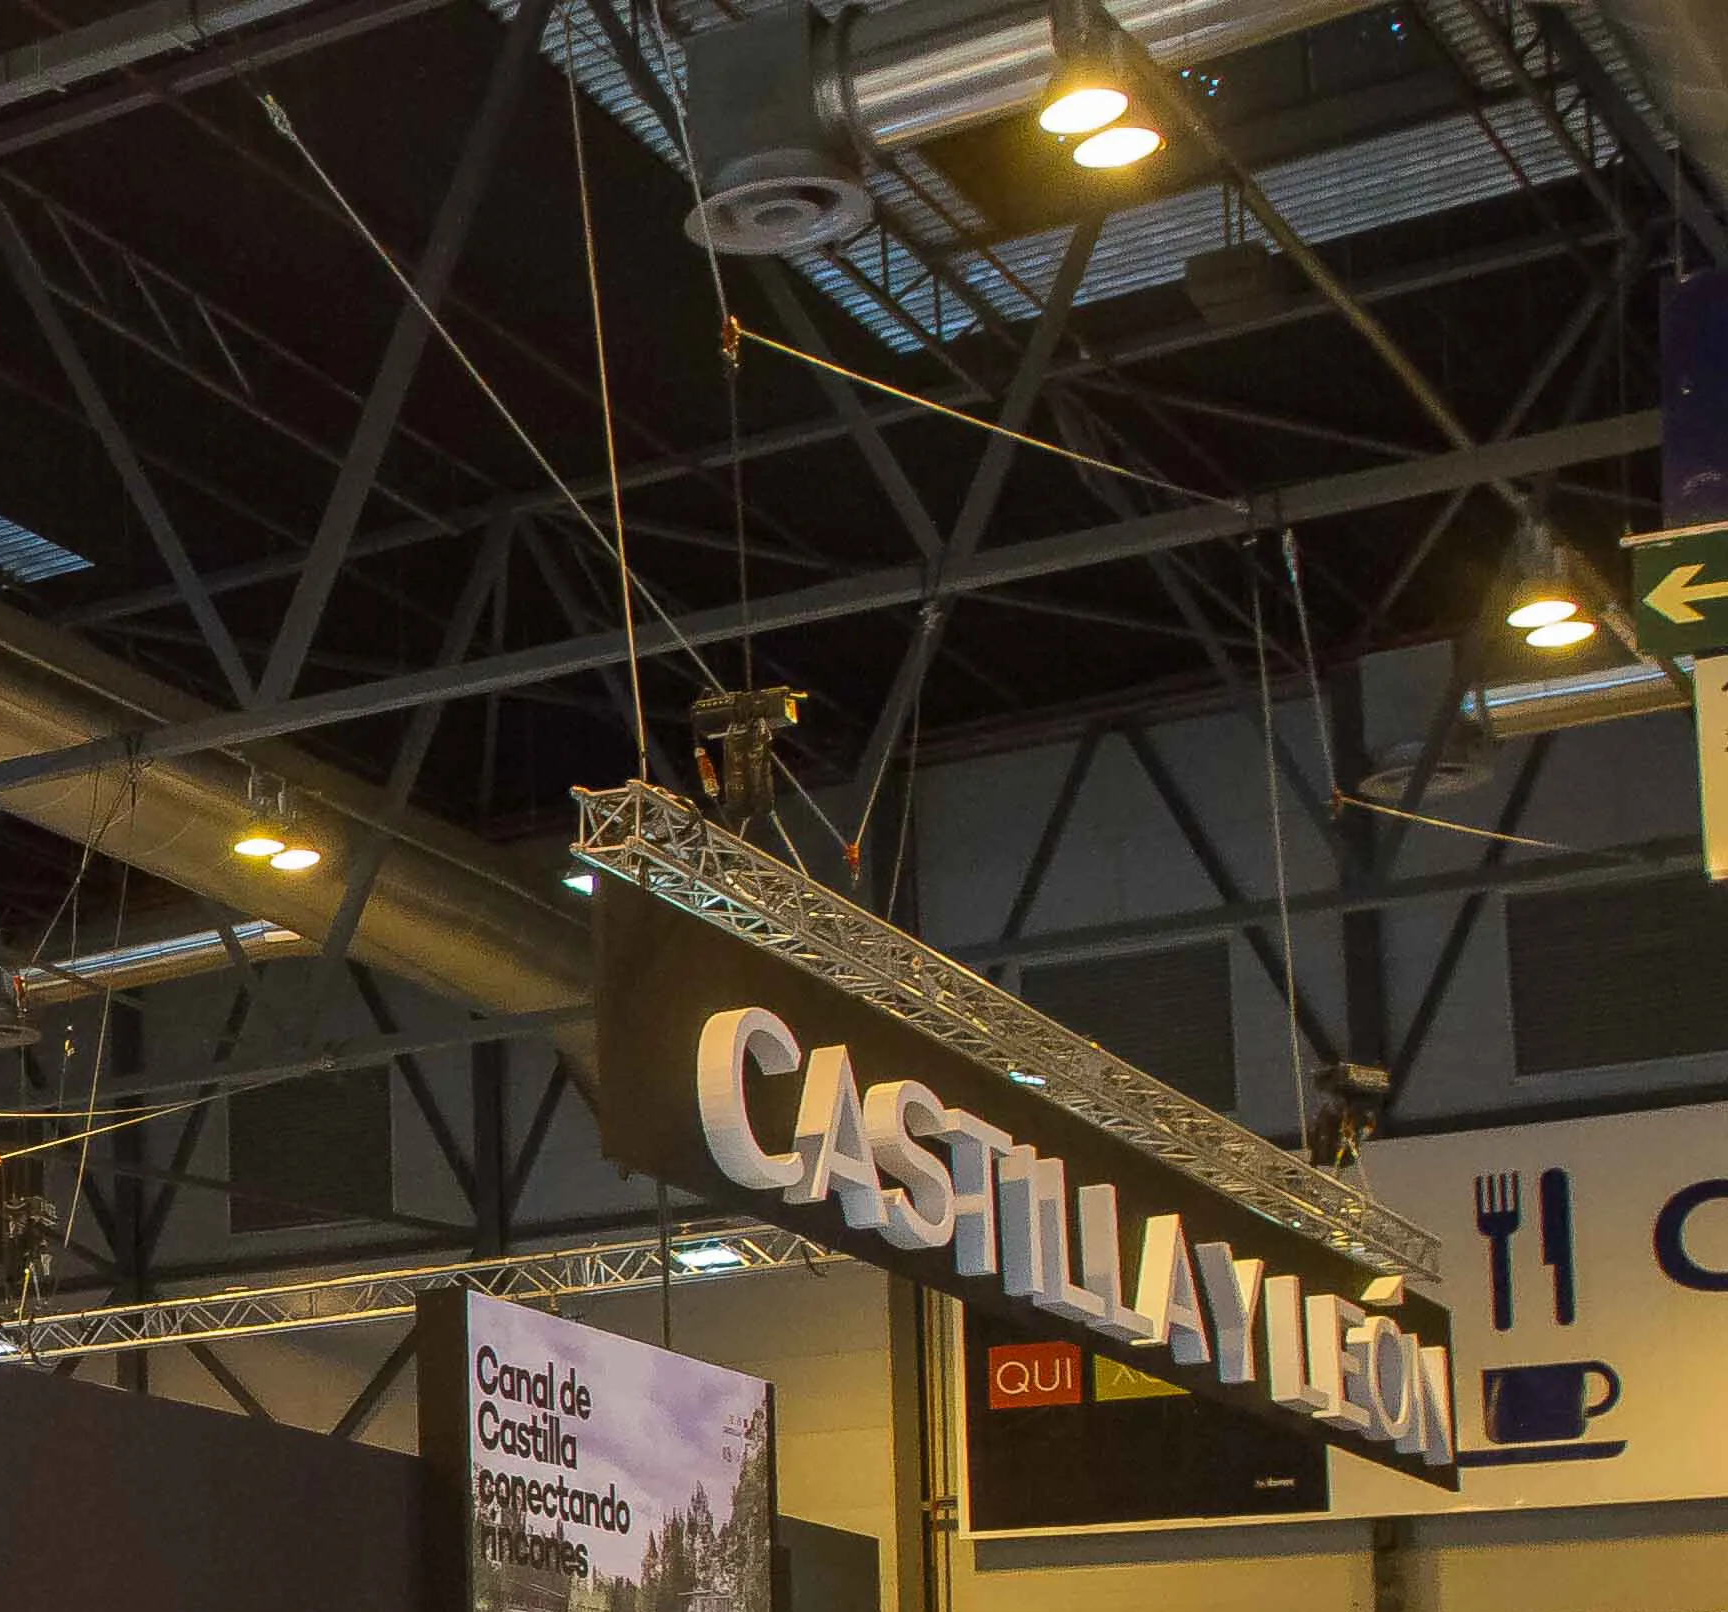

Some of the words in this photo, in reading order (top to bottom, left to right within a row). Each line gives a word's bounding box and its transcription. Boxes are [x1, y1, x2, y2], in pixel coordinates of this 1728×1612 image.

[697, 1007, 1212, 1366] CASTILLA
[1194, 1241, 1266, 1384] Y
[1265, 1275, 1453, 1466] LEÓN
[476, 1345, 555, 1411] Canal
[560, 1368, 592, 1420] de
[478, 1400, 578, 1470] Castilla
[479, 1474, 631, 1534] conectando
[481, 1523, 589, 1579] rincones
